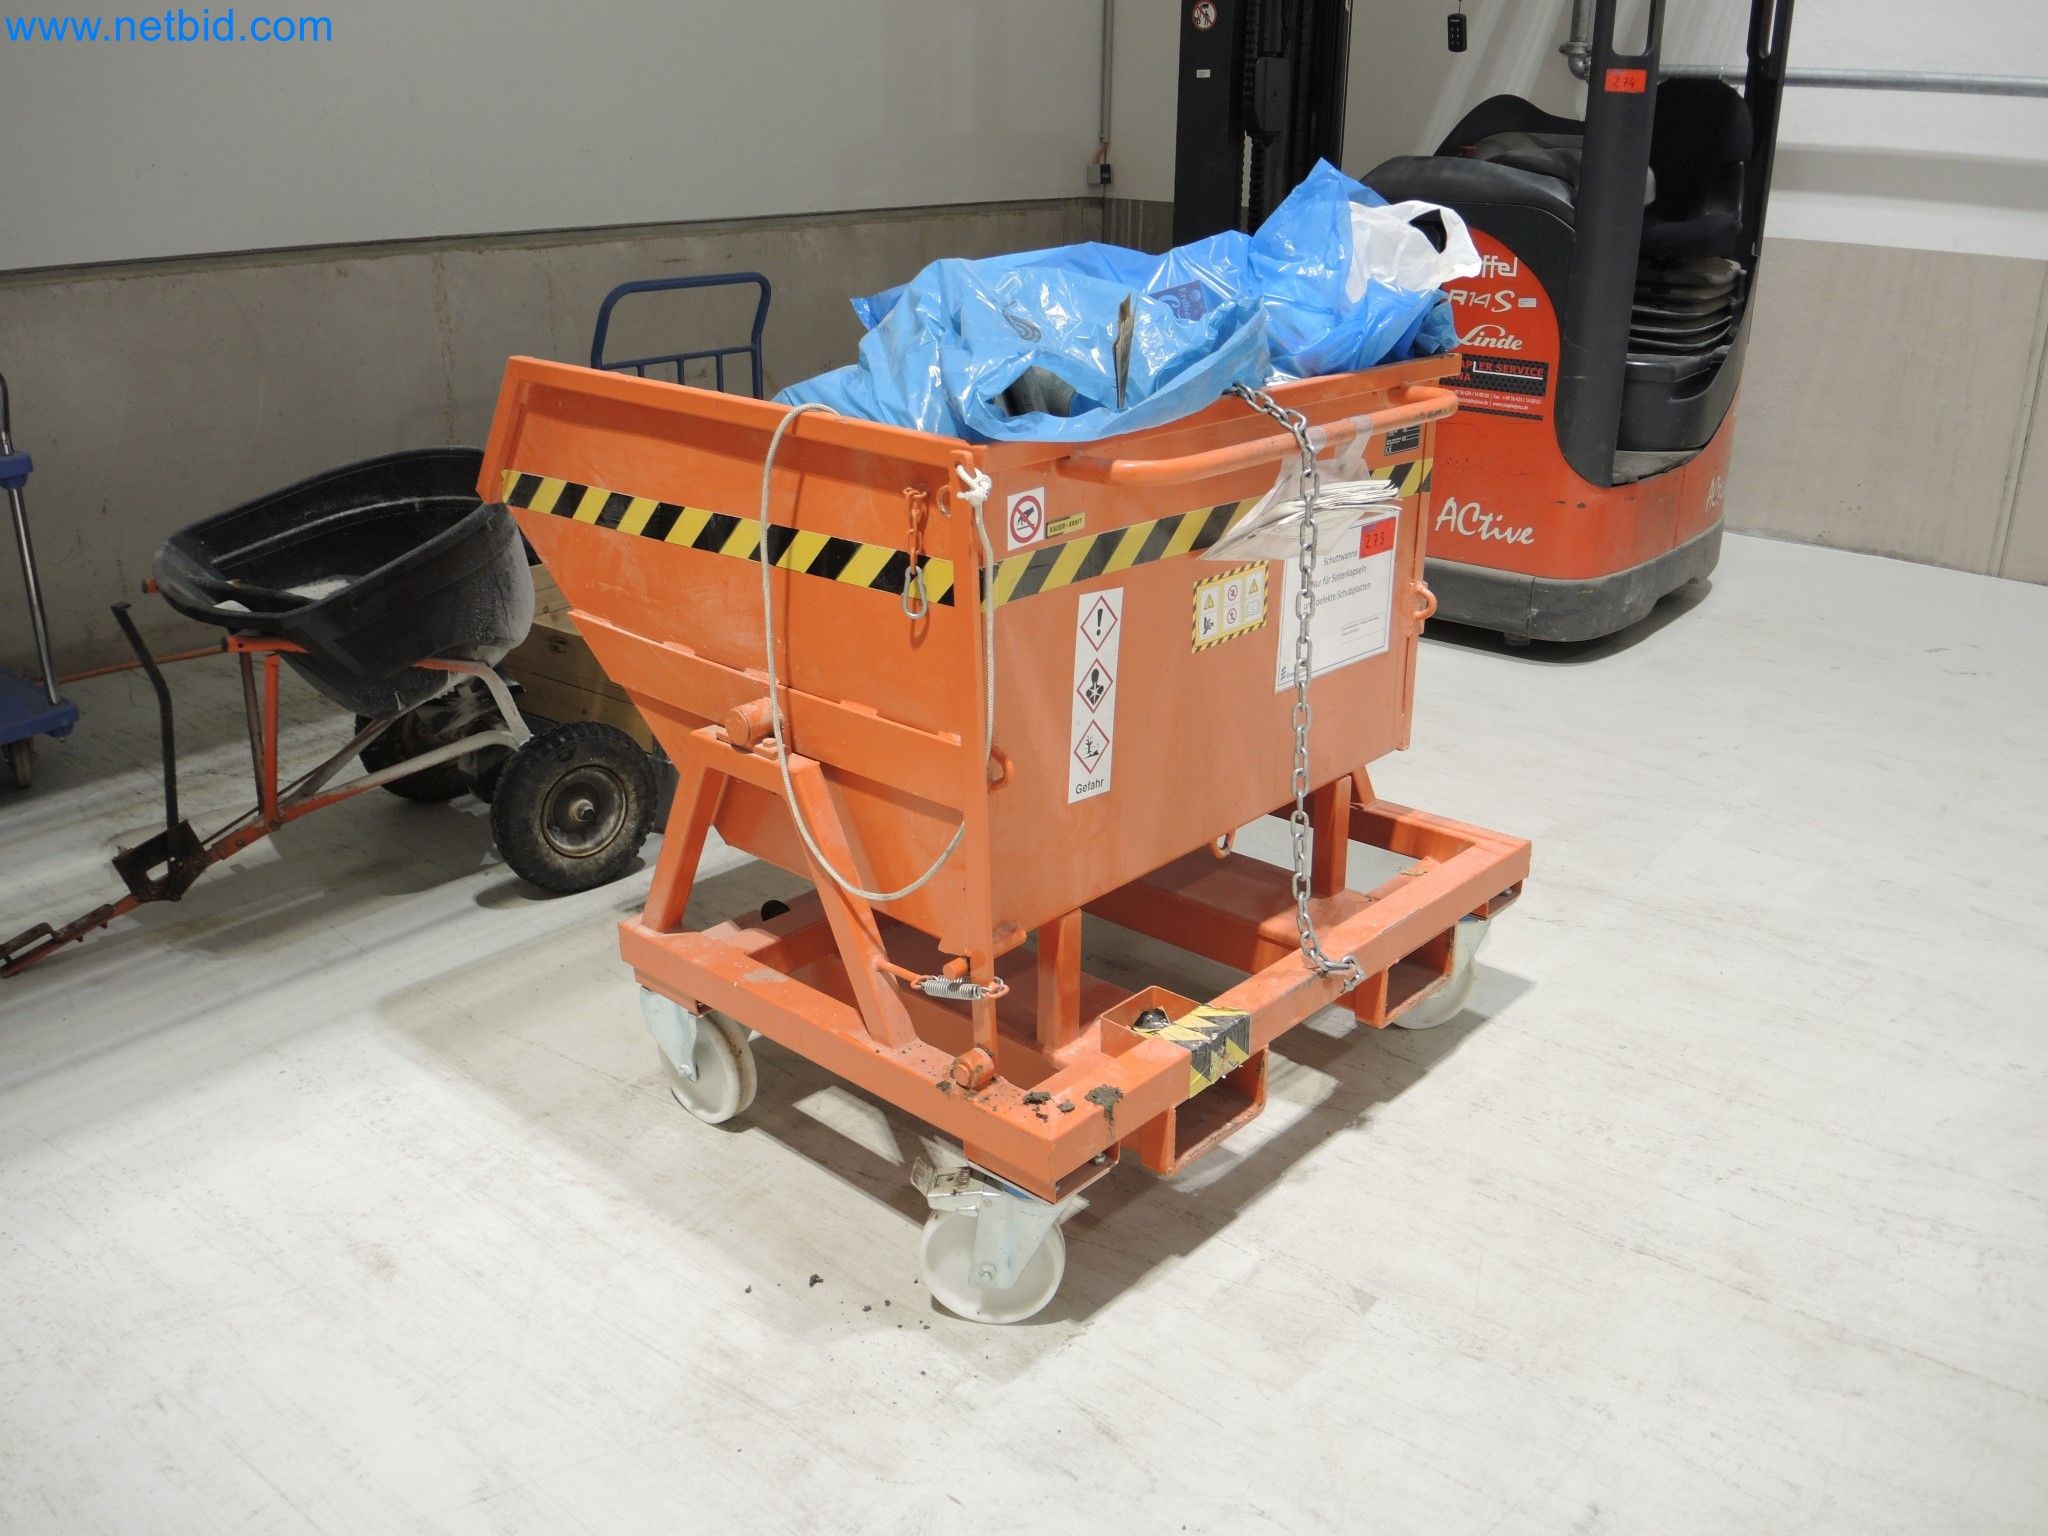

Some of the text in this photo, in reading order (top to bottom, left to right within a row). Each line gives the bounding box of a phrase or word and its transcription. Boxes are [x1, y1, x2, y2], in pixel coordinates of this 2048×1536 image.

[1481, 254, 1518, 278] ffel
[1460, 324, 1523, 351] Linde
[1461, 360, 1544, 377] APLER SERVICE
[1435, 496, 1534, 544] ACtive
[1365, 531, 1385, 549] 273
[1322, 575, 1331, 586] für
[1331, 564, 1367, 583] Sinterkapseln
[1075, 778, 1105, 795] Gefahr
